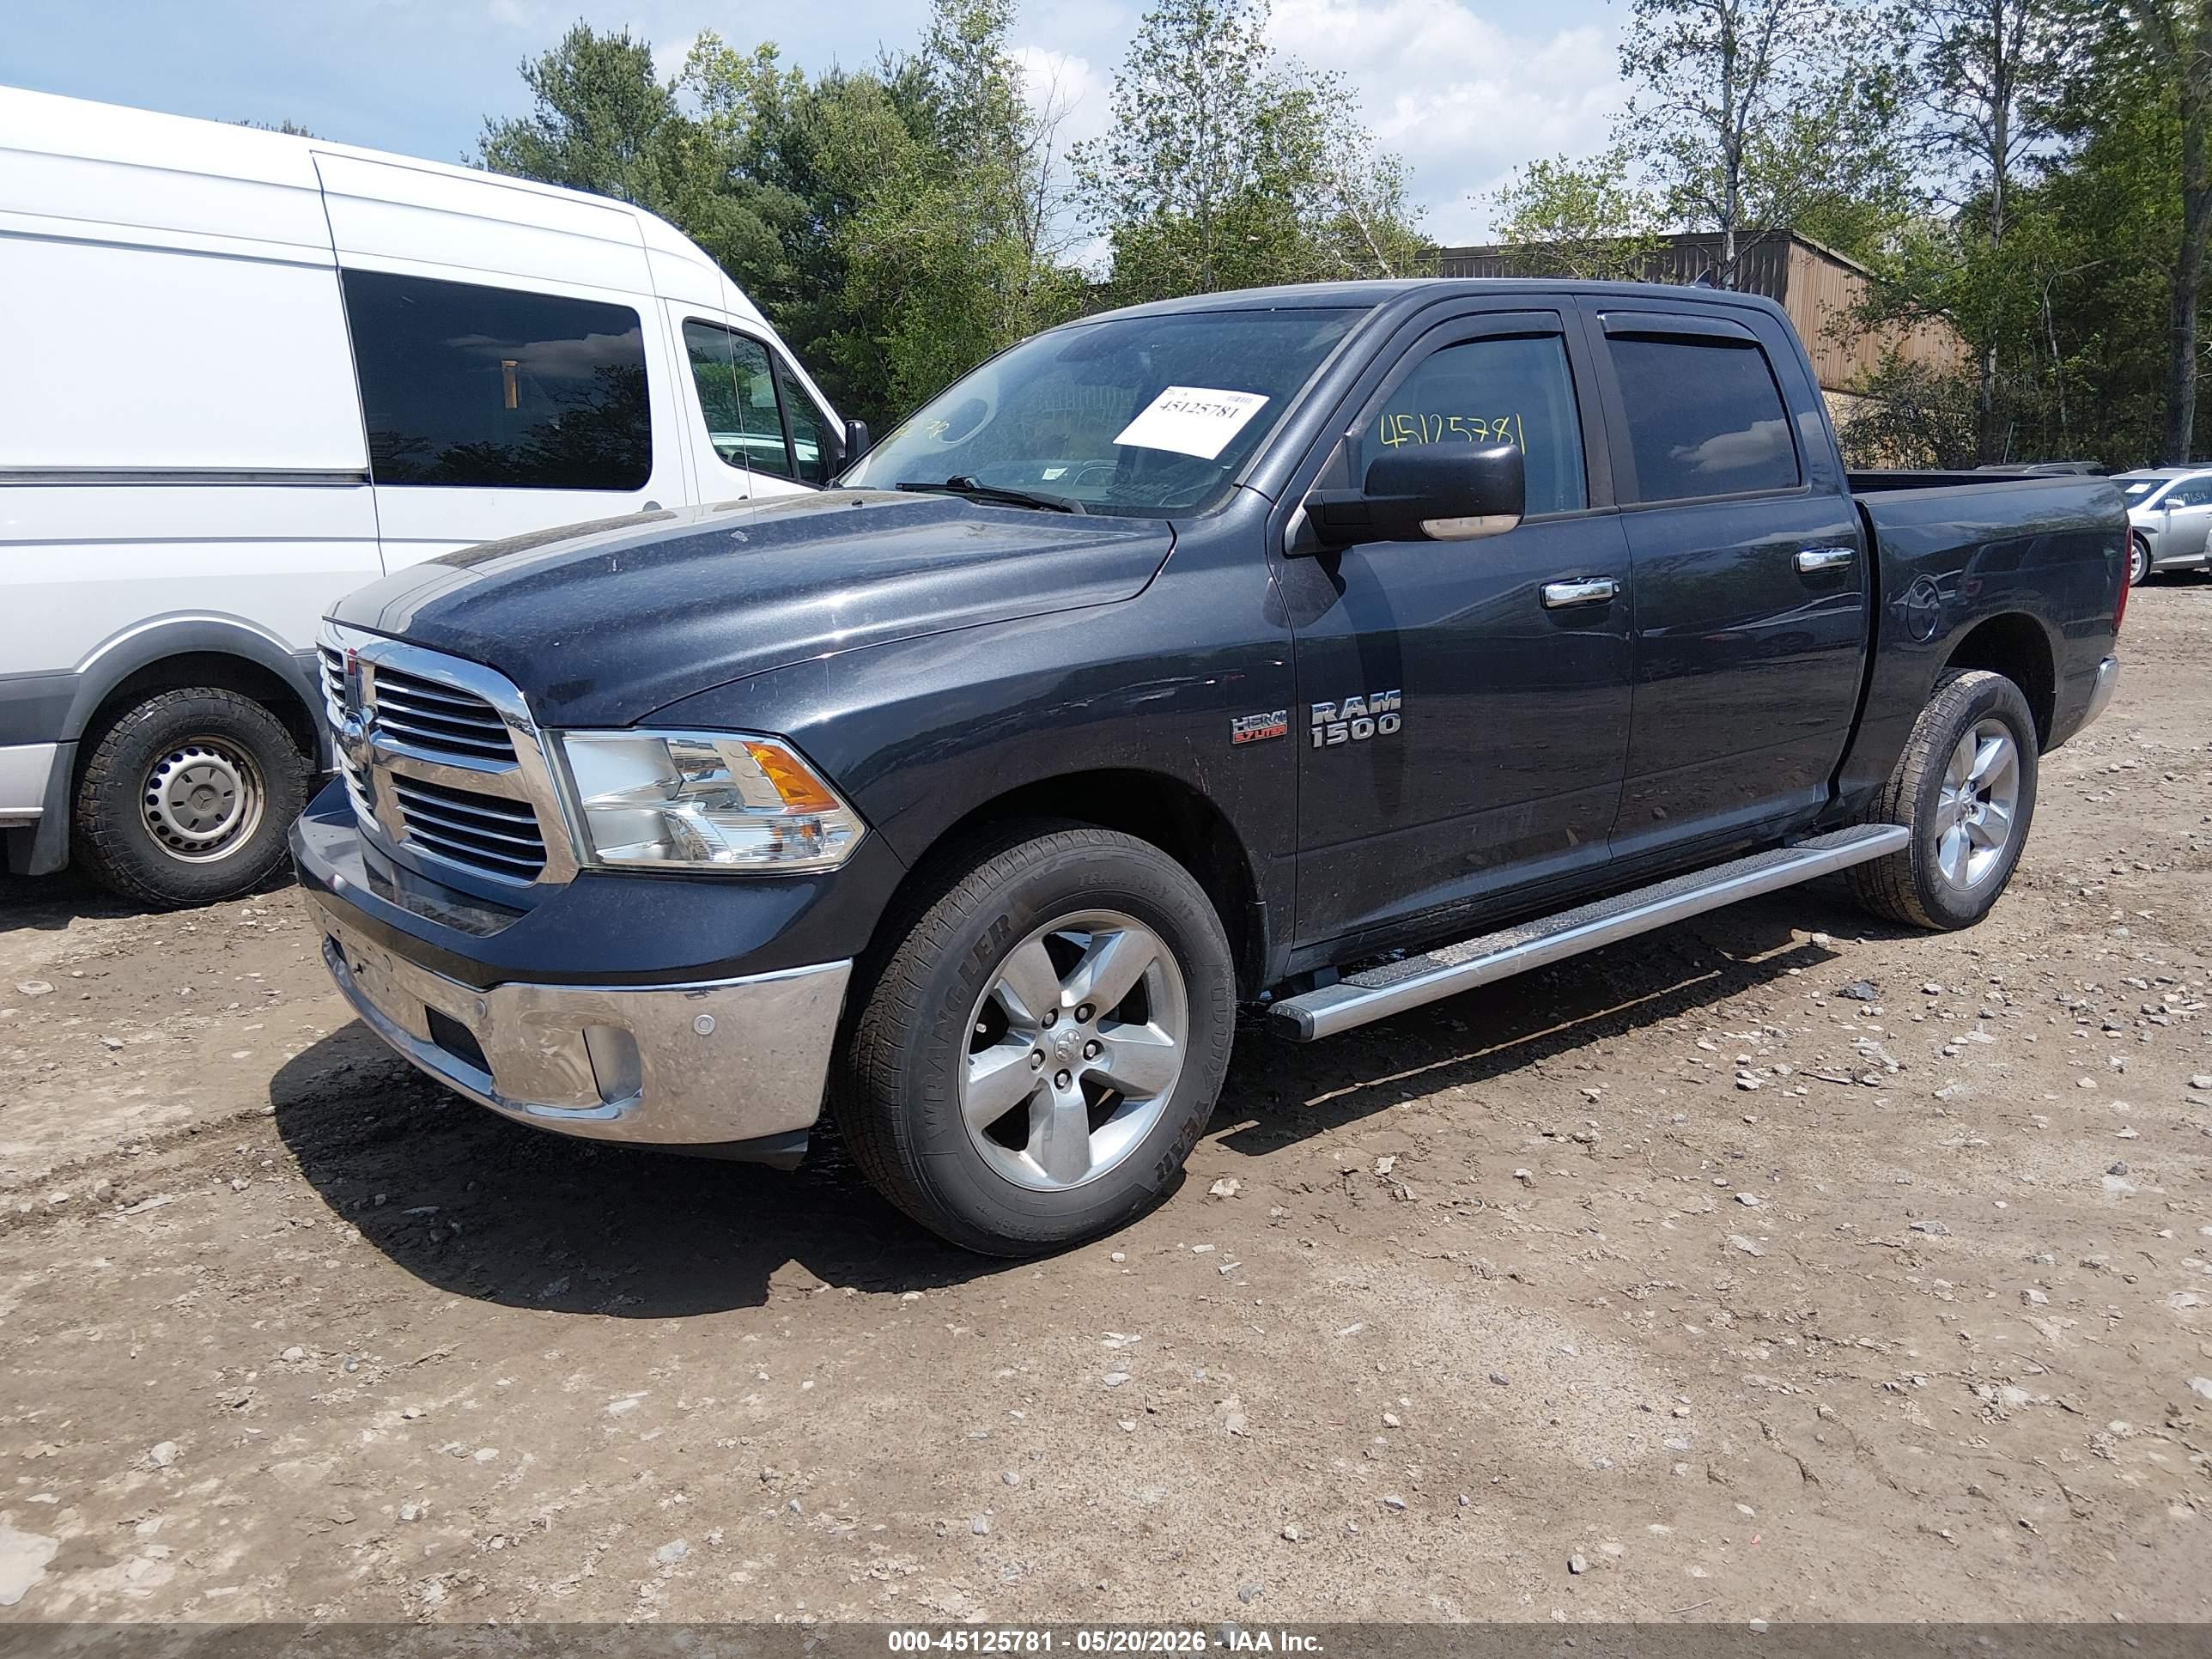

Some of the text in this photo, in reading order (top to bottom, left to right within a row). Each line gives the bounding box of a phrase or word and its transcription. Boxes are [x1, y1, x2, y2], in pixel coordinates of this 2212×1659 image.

[1159, 399, 1239, 419] 45125781
[1380, 413, 1526, 455] 45125781
[1230, 710, 1287, 732] HEMI
[1310, 689, 1401, 725] RAM
[1310, 712, 1401, 749] 1500
[923, 913, 1013, 1141] WRANGLER
